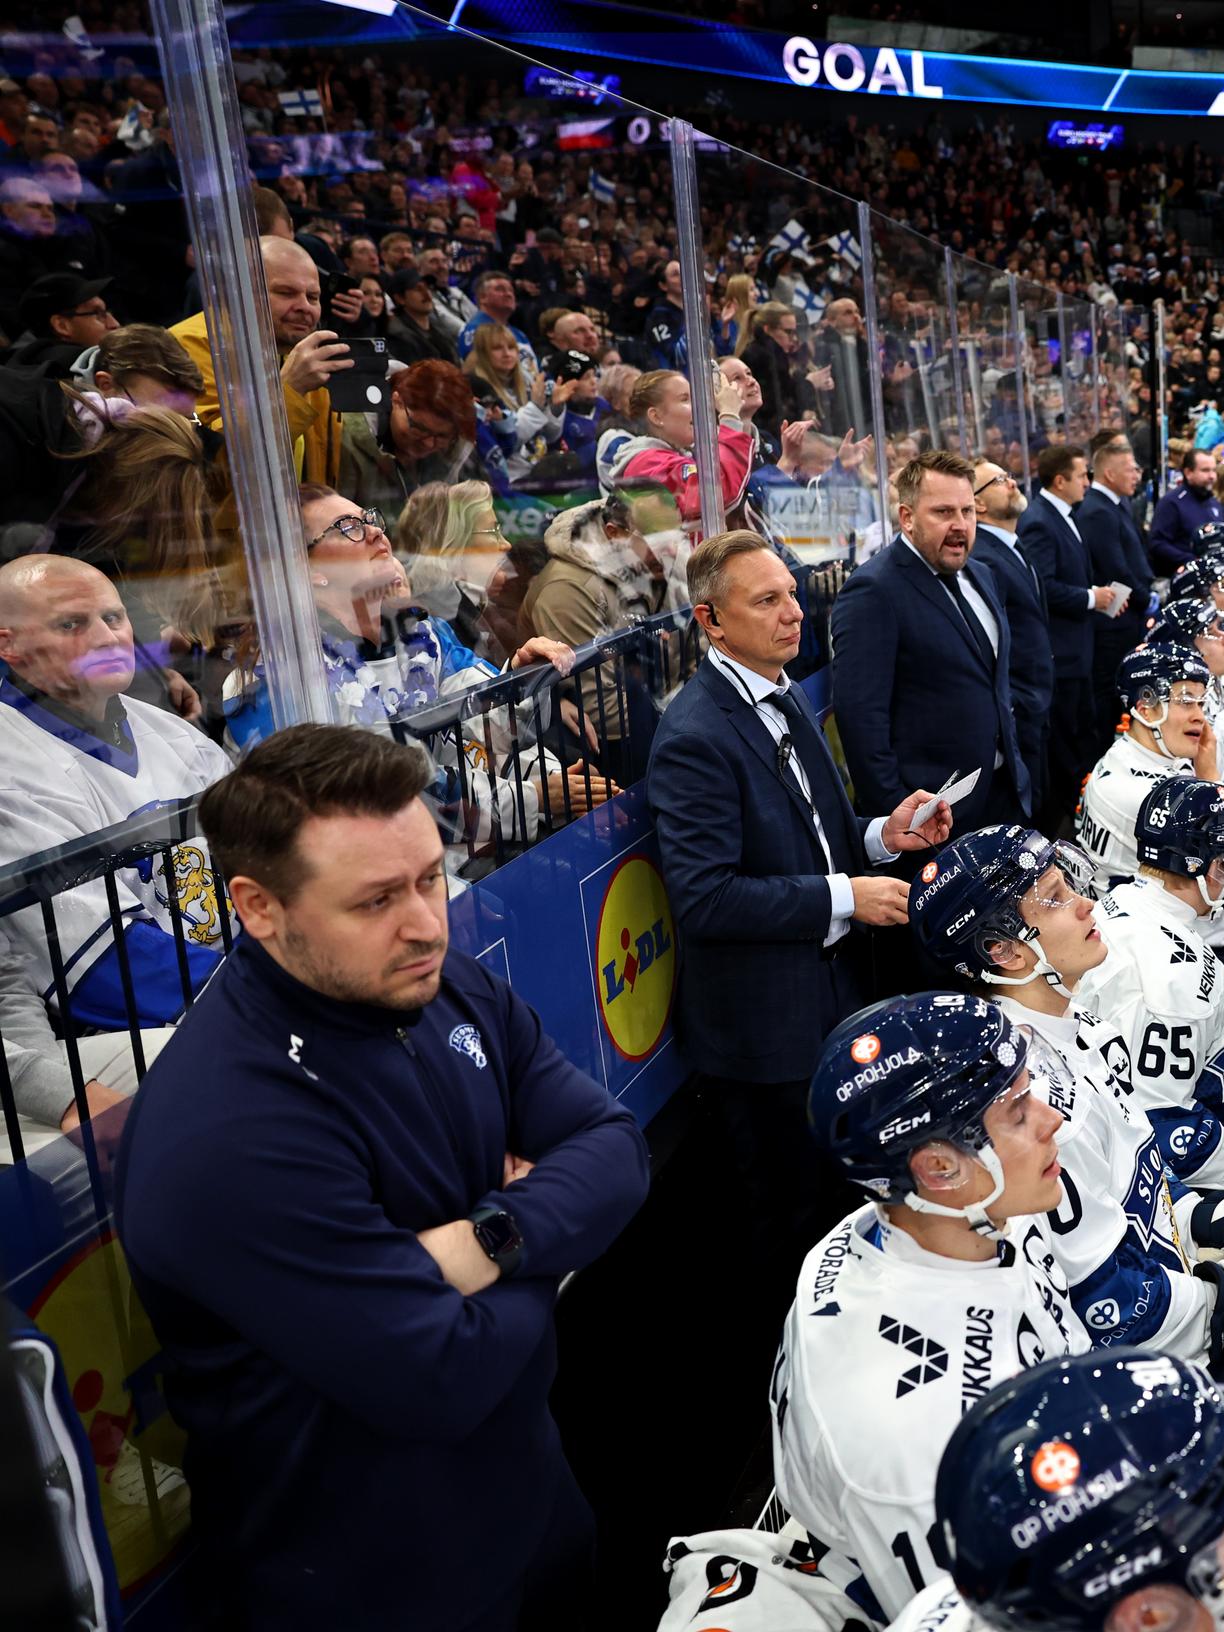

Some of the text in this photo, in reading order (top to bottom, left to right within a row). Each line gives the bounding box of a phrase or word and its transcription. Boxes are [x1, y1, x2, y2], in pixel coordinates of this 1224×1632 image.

[782, 36, 943, 98] GOAL
[652, 323, 672, 342] 12
[1148, 807, 1170, 829] 65
[915, 865, 962, 911] OP POHJOLA
[946, 909, 976, 937] CCM
[836, 1046, 922, 1102] OP POHJOLA
[1137, 1022, 1195, 1081] 65
[879, 1110, 932, 1144] CCM
[1010, 1458, 1143, 1549] OP POHJOLA
[1084, 1546, 1163, 1598] CCM
